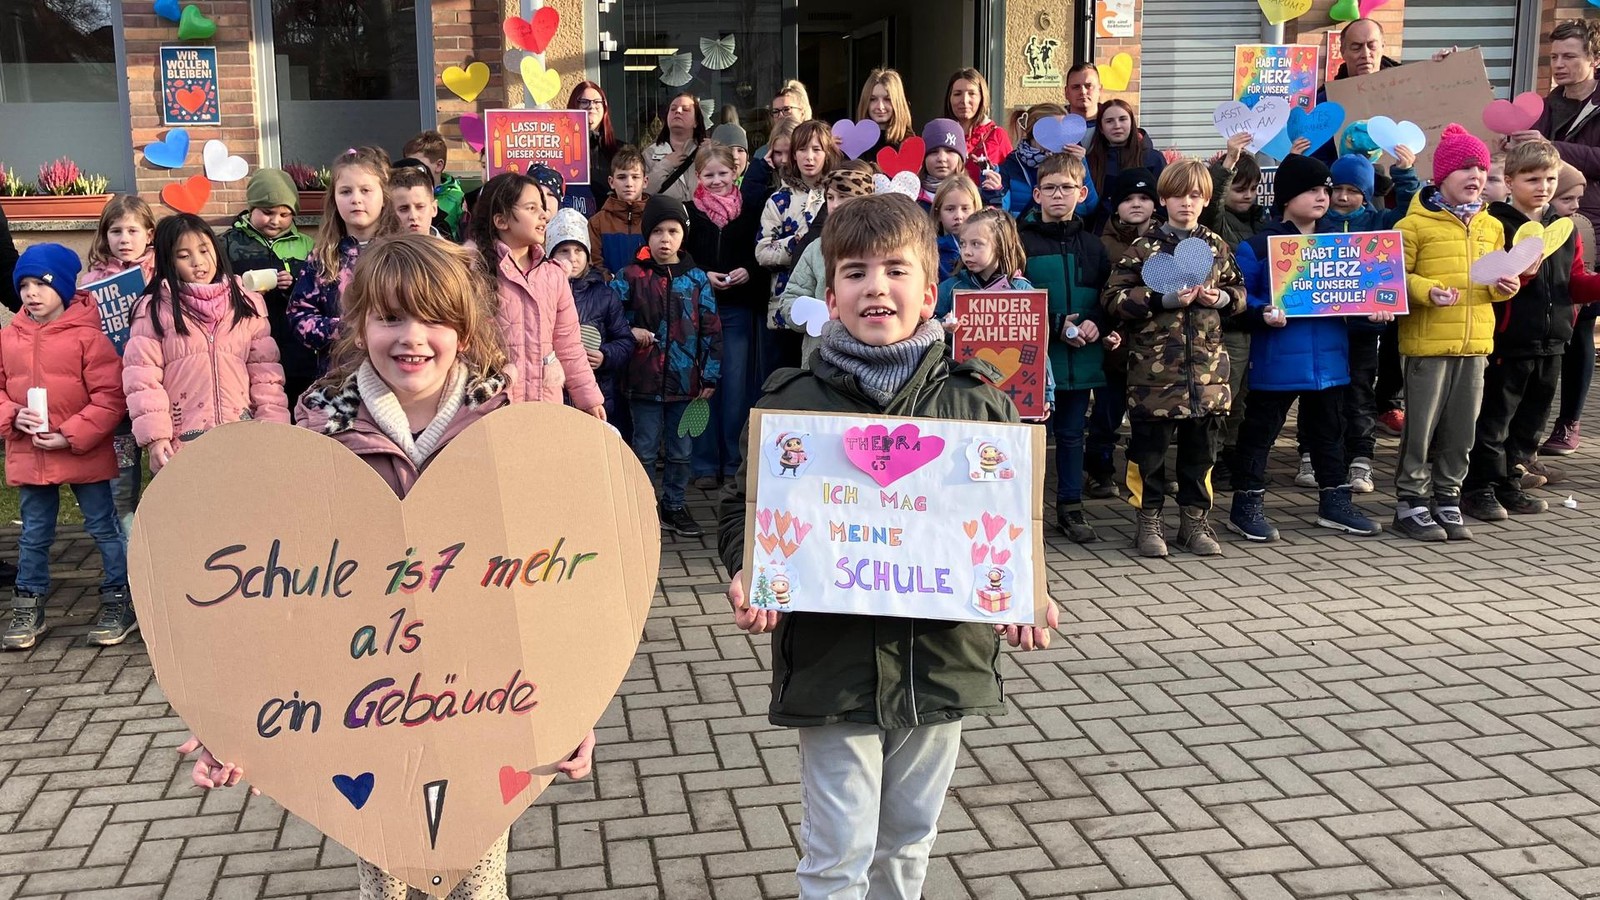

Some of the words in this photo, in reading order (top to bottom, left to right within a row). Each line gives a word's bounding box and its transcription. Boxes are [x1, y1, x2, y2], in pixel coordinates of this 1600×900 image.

[176, 51, 199, 60] WIR
[1255, 57, 1276, 68] HABT
[1278, 58, 1292, 68] EIN
[166, 60, 209, 70] WOLLEN
[167, 69, 212, 79] BLEIBEN!
[1259, 70, 1291, 83] HERZ
[1247, 83, 1261, 94] FÜR
[1262, 85, 1289, 94] UNSERE
[1214, 107, 1241, 123] LASST
[1256, 102, 1276, 113] DAS
[511, 122, 538, 132] LASST
[540, 123, 555, 132] DIE
[506, 134, 561, 148] LICHTER
[507, 150, 534, 158] DIESER
[536, 150, 564, 159] SCHULE
[1301, 247, 1335, 261] HABT
[1338, 246, 1361, 258] EIN
[1309, 260, 1361, 278] HERZ
[1292, 277, 1313, 291] FÜR
[1316, 279, 1360, 290] UNSERE
[1311, 289, 1367, 304] SCHULE!
[1380, 292, 1394, 301] 1+2
[968, 298, 1031, 313] KINDER
[960, 313, 995, 326] SIND
[998, 313, 1040, 326] KEINE
[961, 326, 1037, 341] ZAHLEN!
[823, 482, 859, 505] ICH
[880, 490, 927, 512] MAG
[829, 520, 903, 547] MEINE
[185, 538, 358, 608] Schule
[480, 537, 599, 590] mehr
[834, 557, 954, 595] SCHULE
[256, 690, 322, 739] ein
[342, 668, 539, 730] Gebäude
